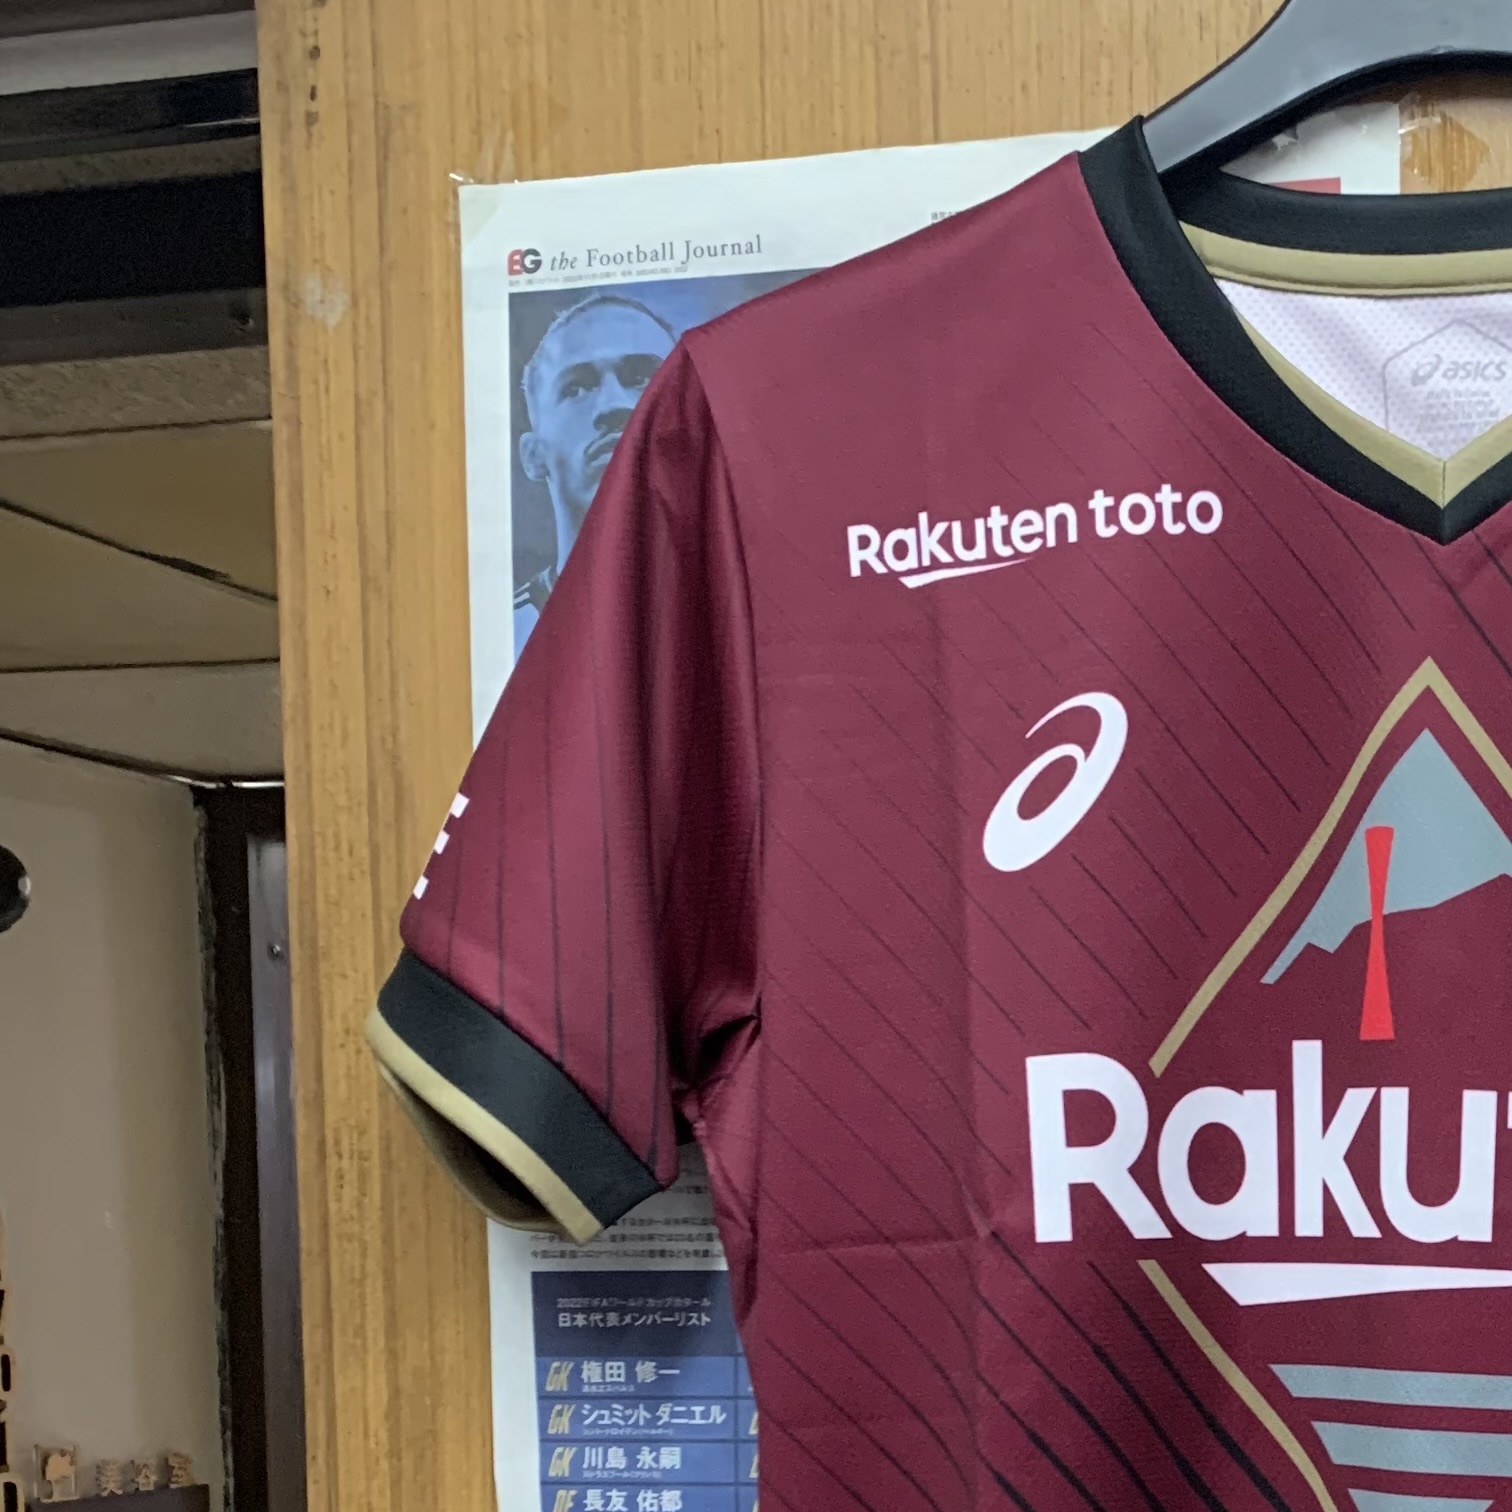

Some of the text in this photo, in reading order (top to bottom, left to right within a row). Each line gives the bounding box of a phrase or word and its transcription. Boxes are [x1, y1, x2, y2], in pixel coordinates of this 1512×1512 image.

[550, 251, 579, 271] the
[586, 242, 676, 268] Football
[681, 234, 763, 265] Journal
[1442, 359, 1507, 382] asics
[846, 483, 1224, 577] Rakuten toto
[583, 1488, 629, 1512] 長友
